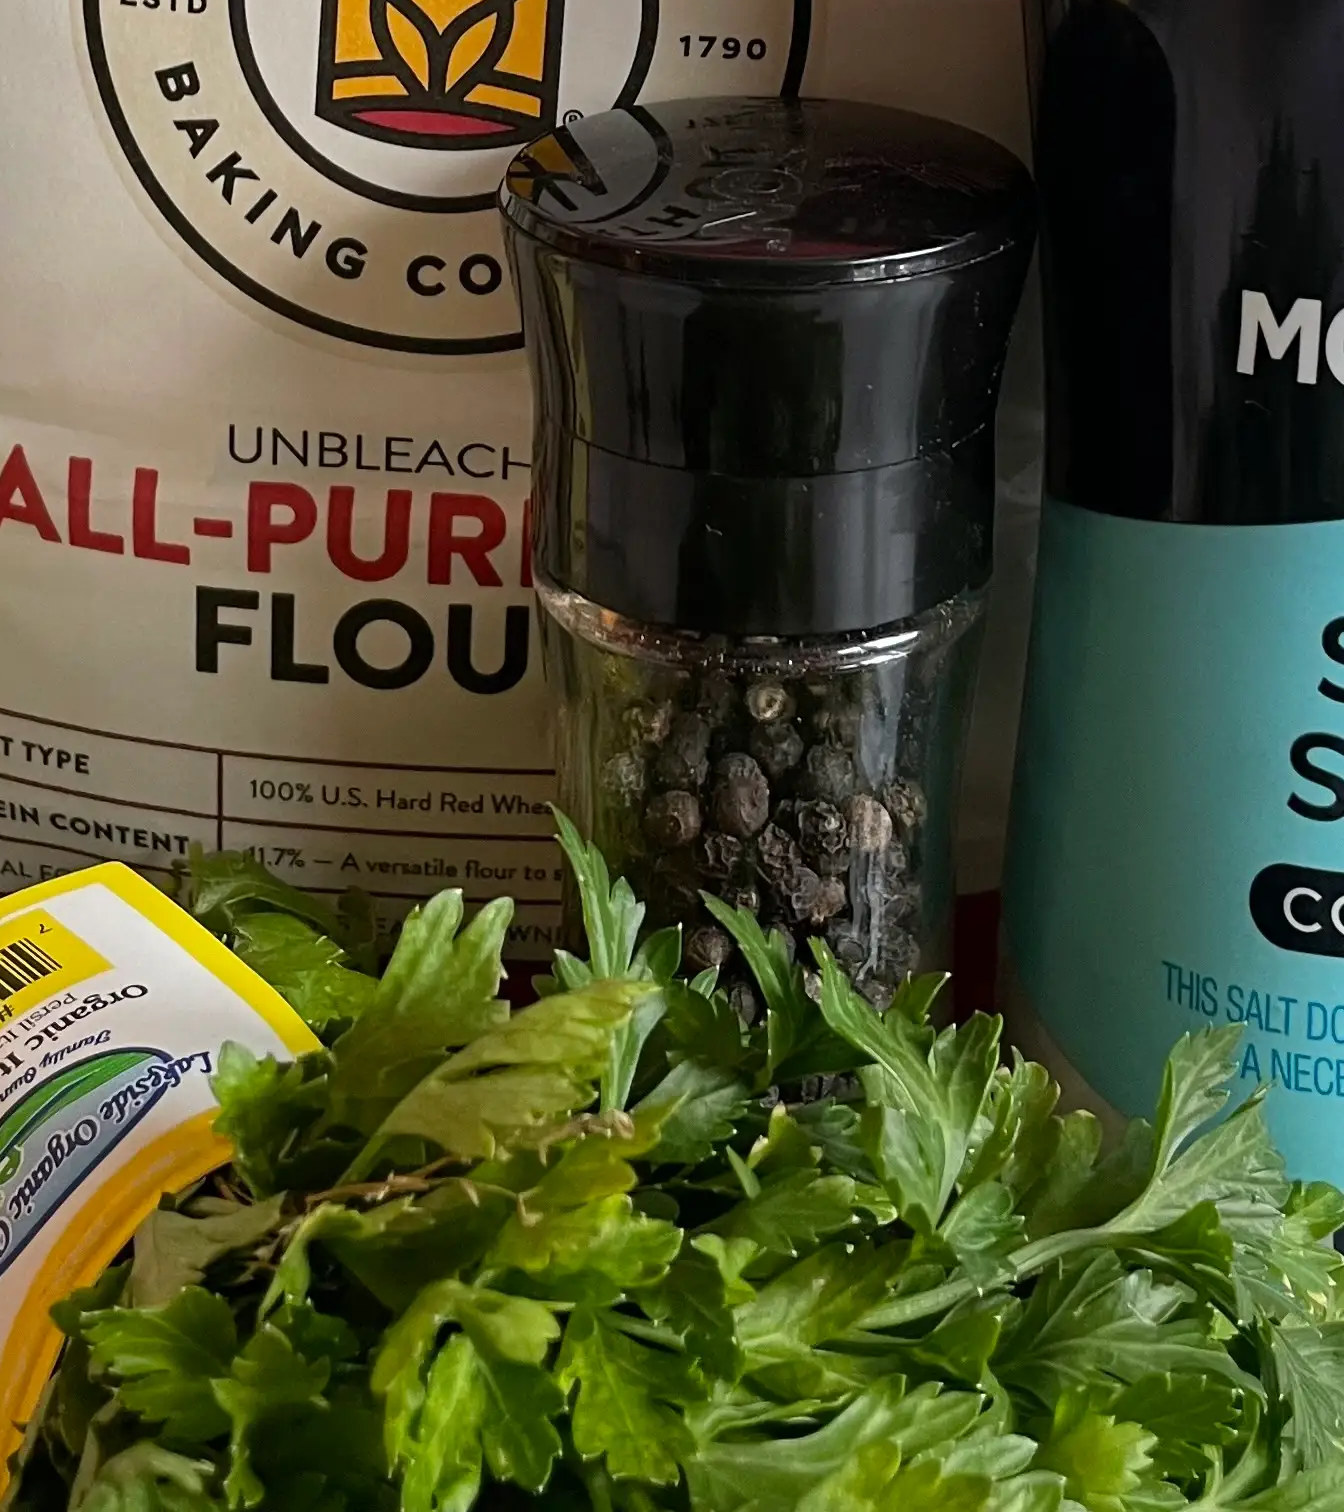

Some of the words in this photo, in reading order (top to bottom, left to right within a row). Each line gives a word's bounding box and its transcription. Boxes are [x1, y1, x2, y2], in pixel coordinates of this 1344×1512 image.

[677, 34, 768, 62] 1790
[155, 59, 368, 282] BAKING
[195, 584, 531, 695] FLOU
[21, 740, 90, 776] TYPE
[249, 779, 314, 803] 100%
[322, 787, 368, 808] U.S.
[377, 789, 431, 811] Hard
[441, 790, 484, 814] Red
[49, 813, 189, 855] CONTENT
[340, 853, 361, 872] A
[366, 857, 458, 878] versatile
[465, 860, 516, 881] flour
[524, 864, 546, 881] to
[19, 991, 78, 1033] Persil
[23, 984, 149, 1051] Organic
[1162, 960, 1218, 1017] THIS
[1226, 987, 1298, 1037] SALT
[39, 1028, 112, 1069] Family
[1241, 1043, 1264, 1082] A
[99, 1050, 212, 1124] Lakeside
[9, 1117, 98, 1221] Organic
